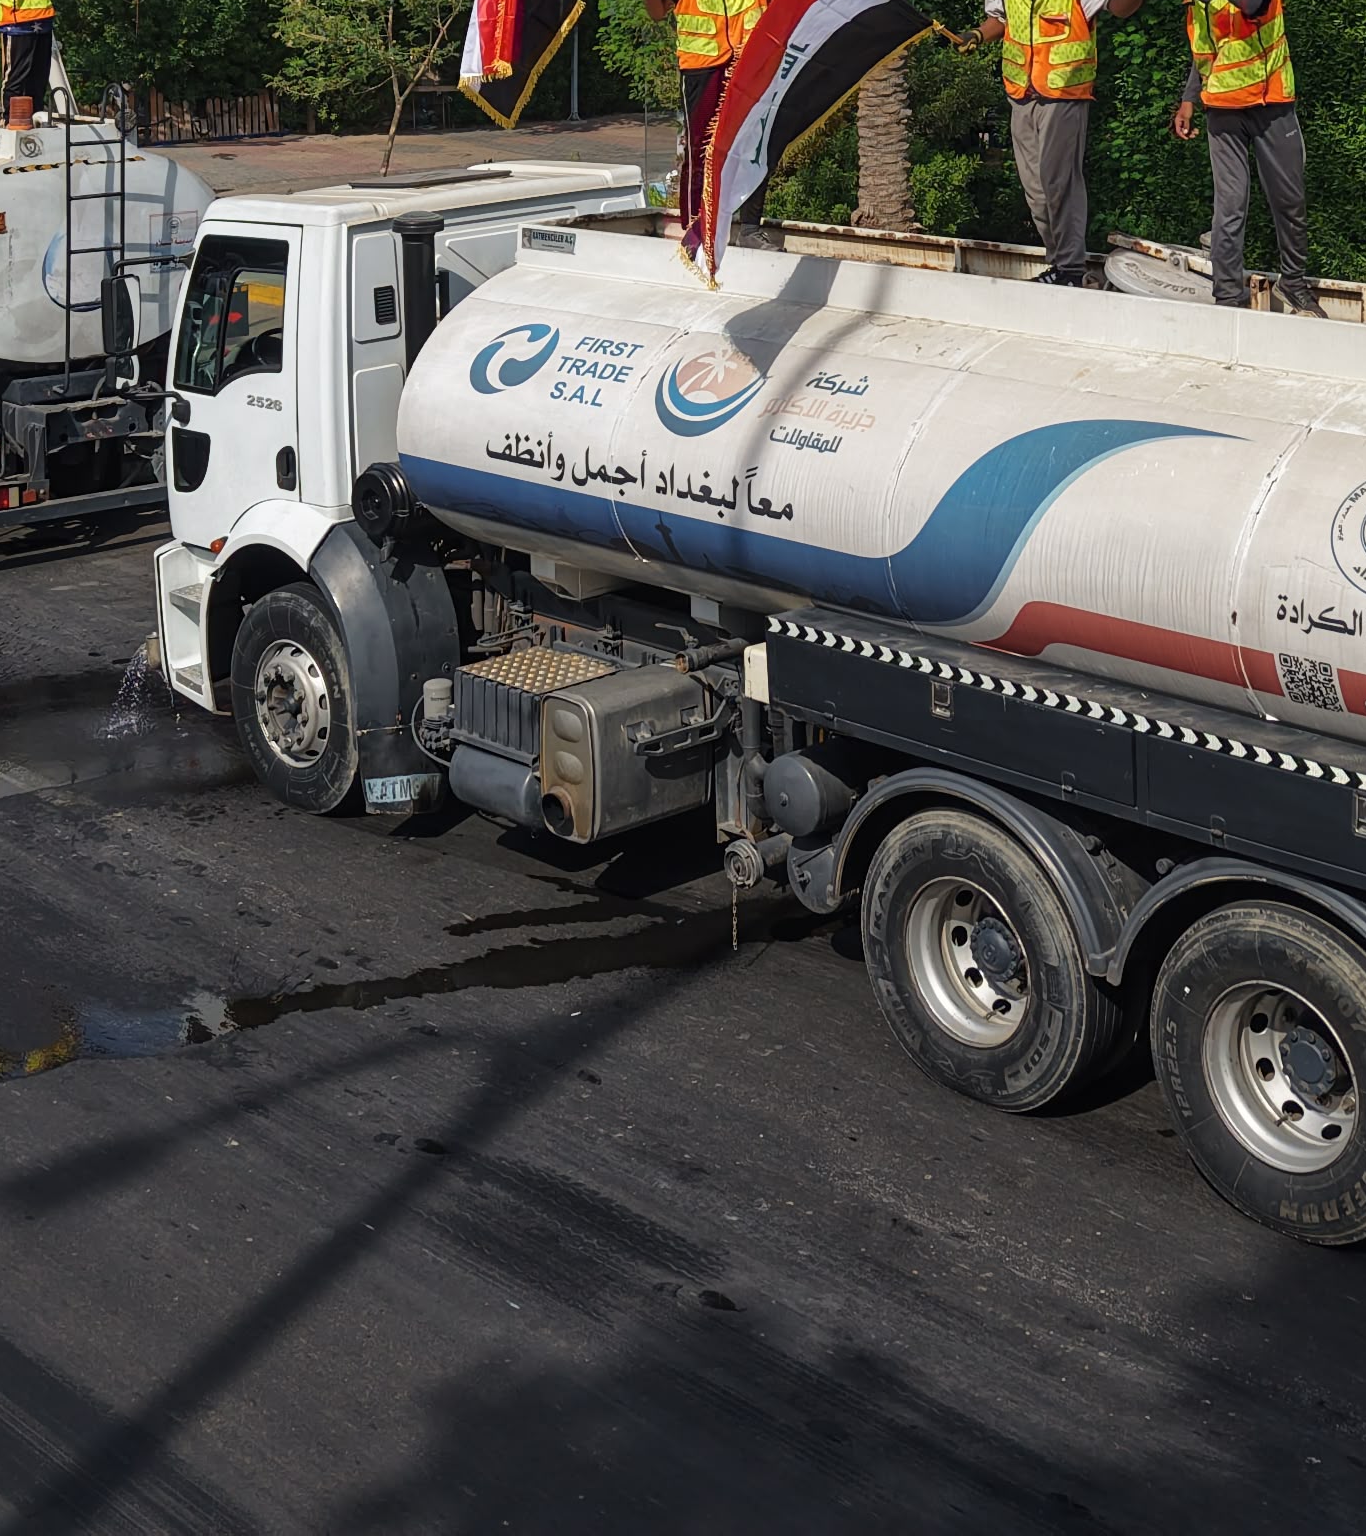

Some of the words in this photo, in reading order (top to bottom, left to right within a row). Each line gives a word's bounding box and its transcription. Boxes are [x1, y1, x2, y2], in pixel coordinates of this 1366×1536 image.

[574, 335, 644, 359] FIRST
[557, 355, 634, 384] TRADE
[805, 371, 870, 396] شركة
[549, 380, 604, 408] S.A.L
[825, 404, 876, 433] جزيرة
[769, 425, 843, 454] للمقاولات
[485, 431, 565, 482] وأنظف
[571, 449, 648, 497] أجمل
[655, 463, 741, 519] لبغداد
[745, 466, 795, 522] معاً
[1276, 593, 1363, 637] الكرادة
